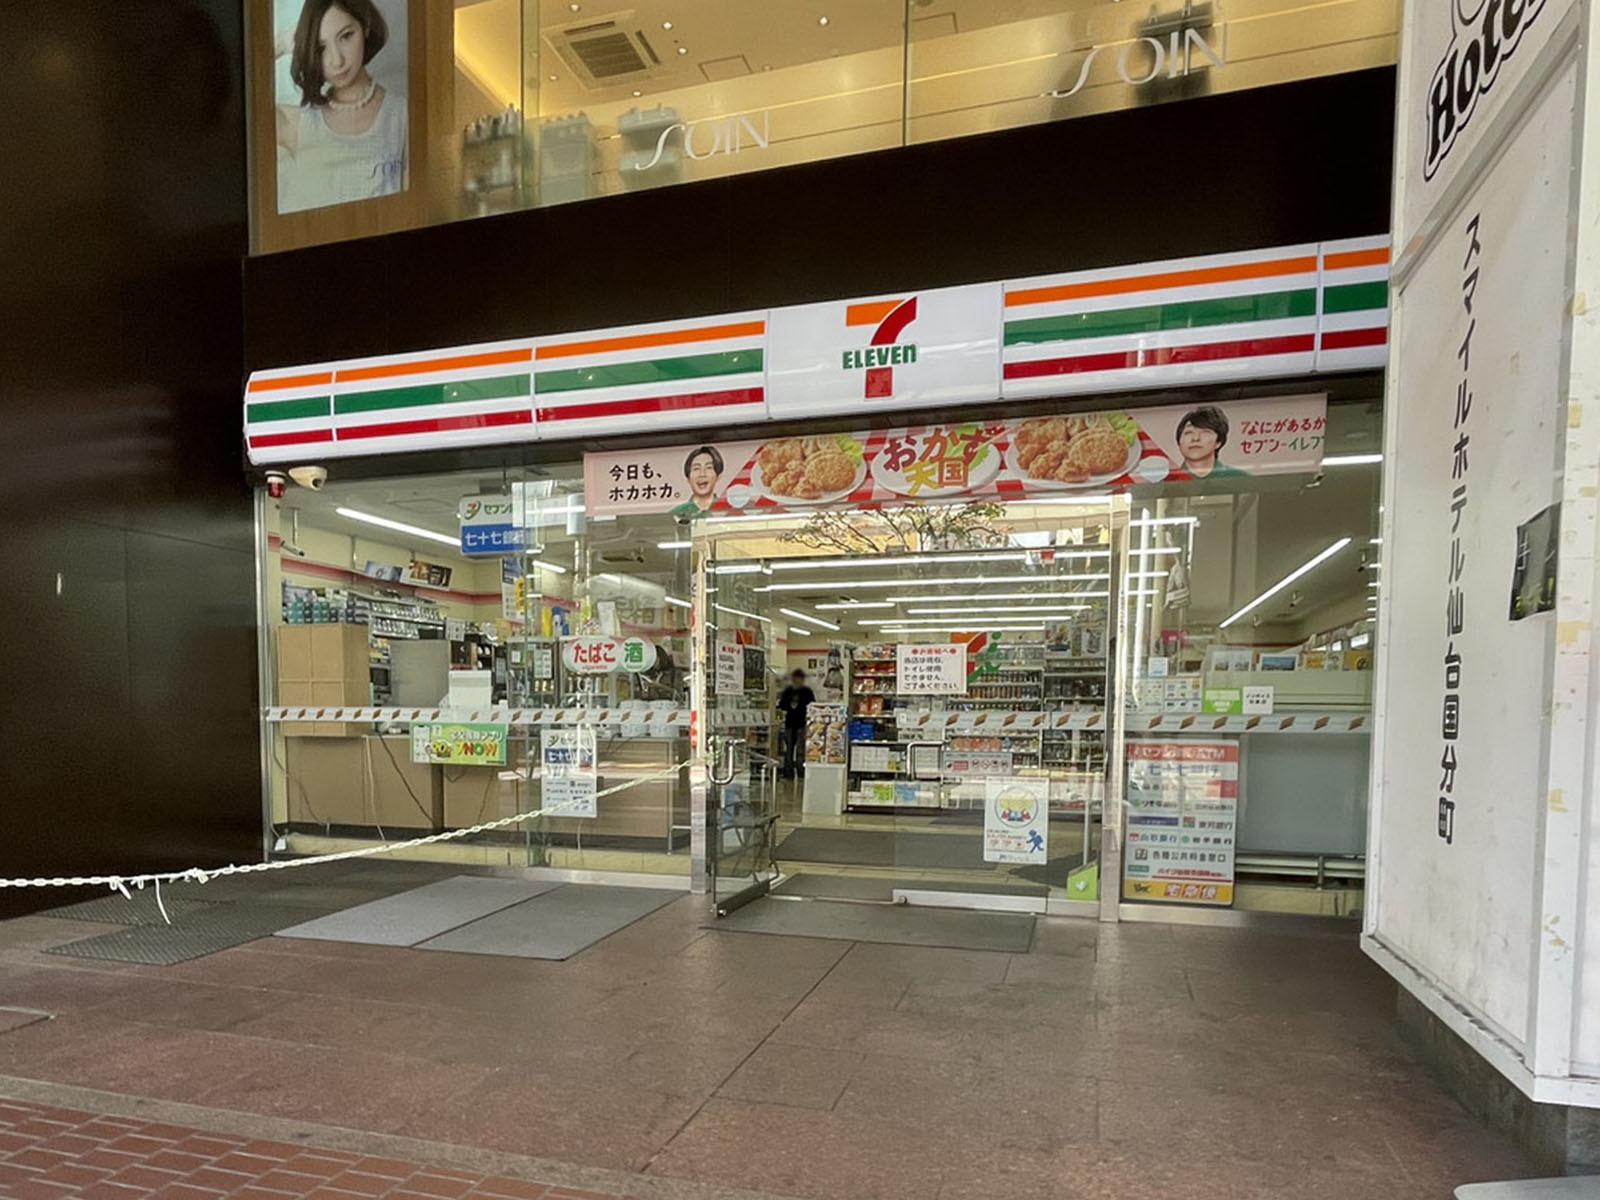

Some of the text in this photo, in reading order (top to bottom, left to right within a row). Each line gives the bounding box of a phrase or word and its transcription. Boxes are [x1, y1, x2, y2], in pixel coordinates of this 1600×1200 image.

[1428, 0, 1536, 166] Hote
[609, 462, 662, 482] 今日も、
[609, 482, 681, 502] ホカホカ。
[1438, 212, 1481, 846] スマイルホテル仙台国分町
[573, 642, 643, 663] たばこ 酒
